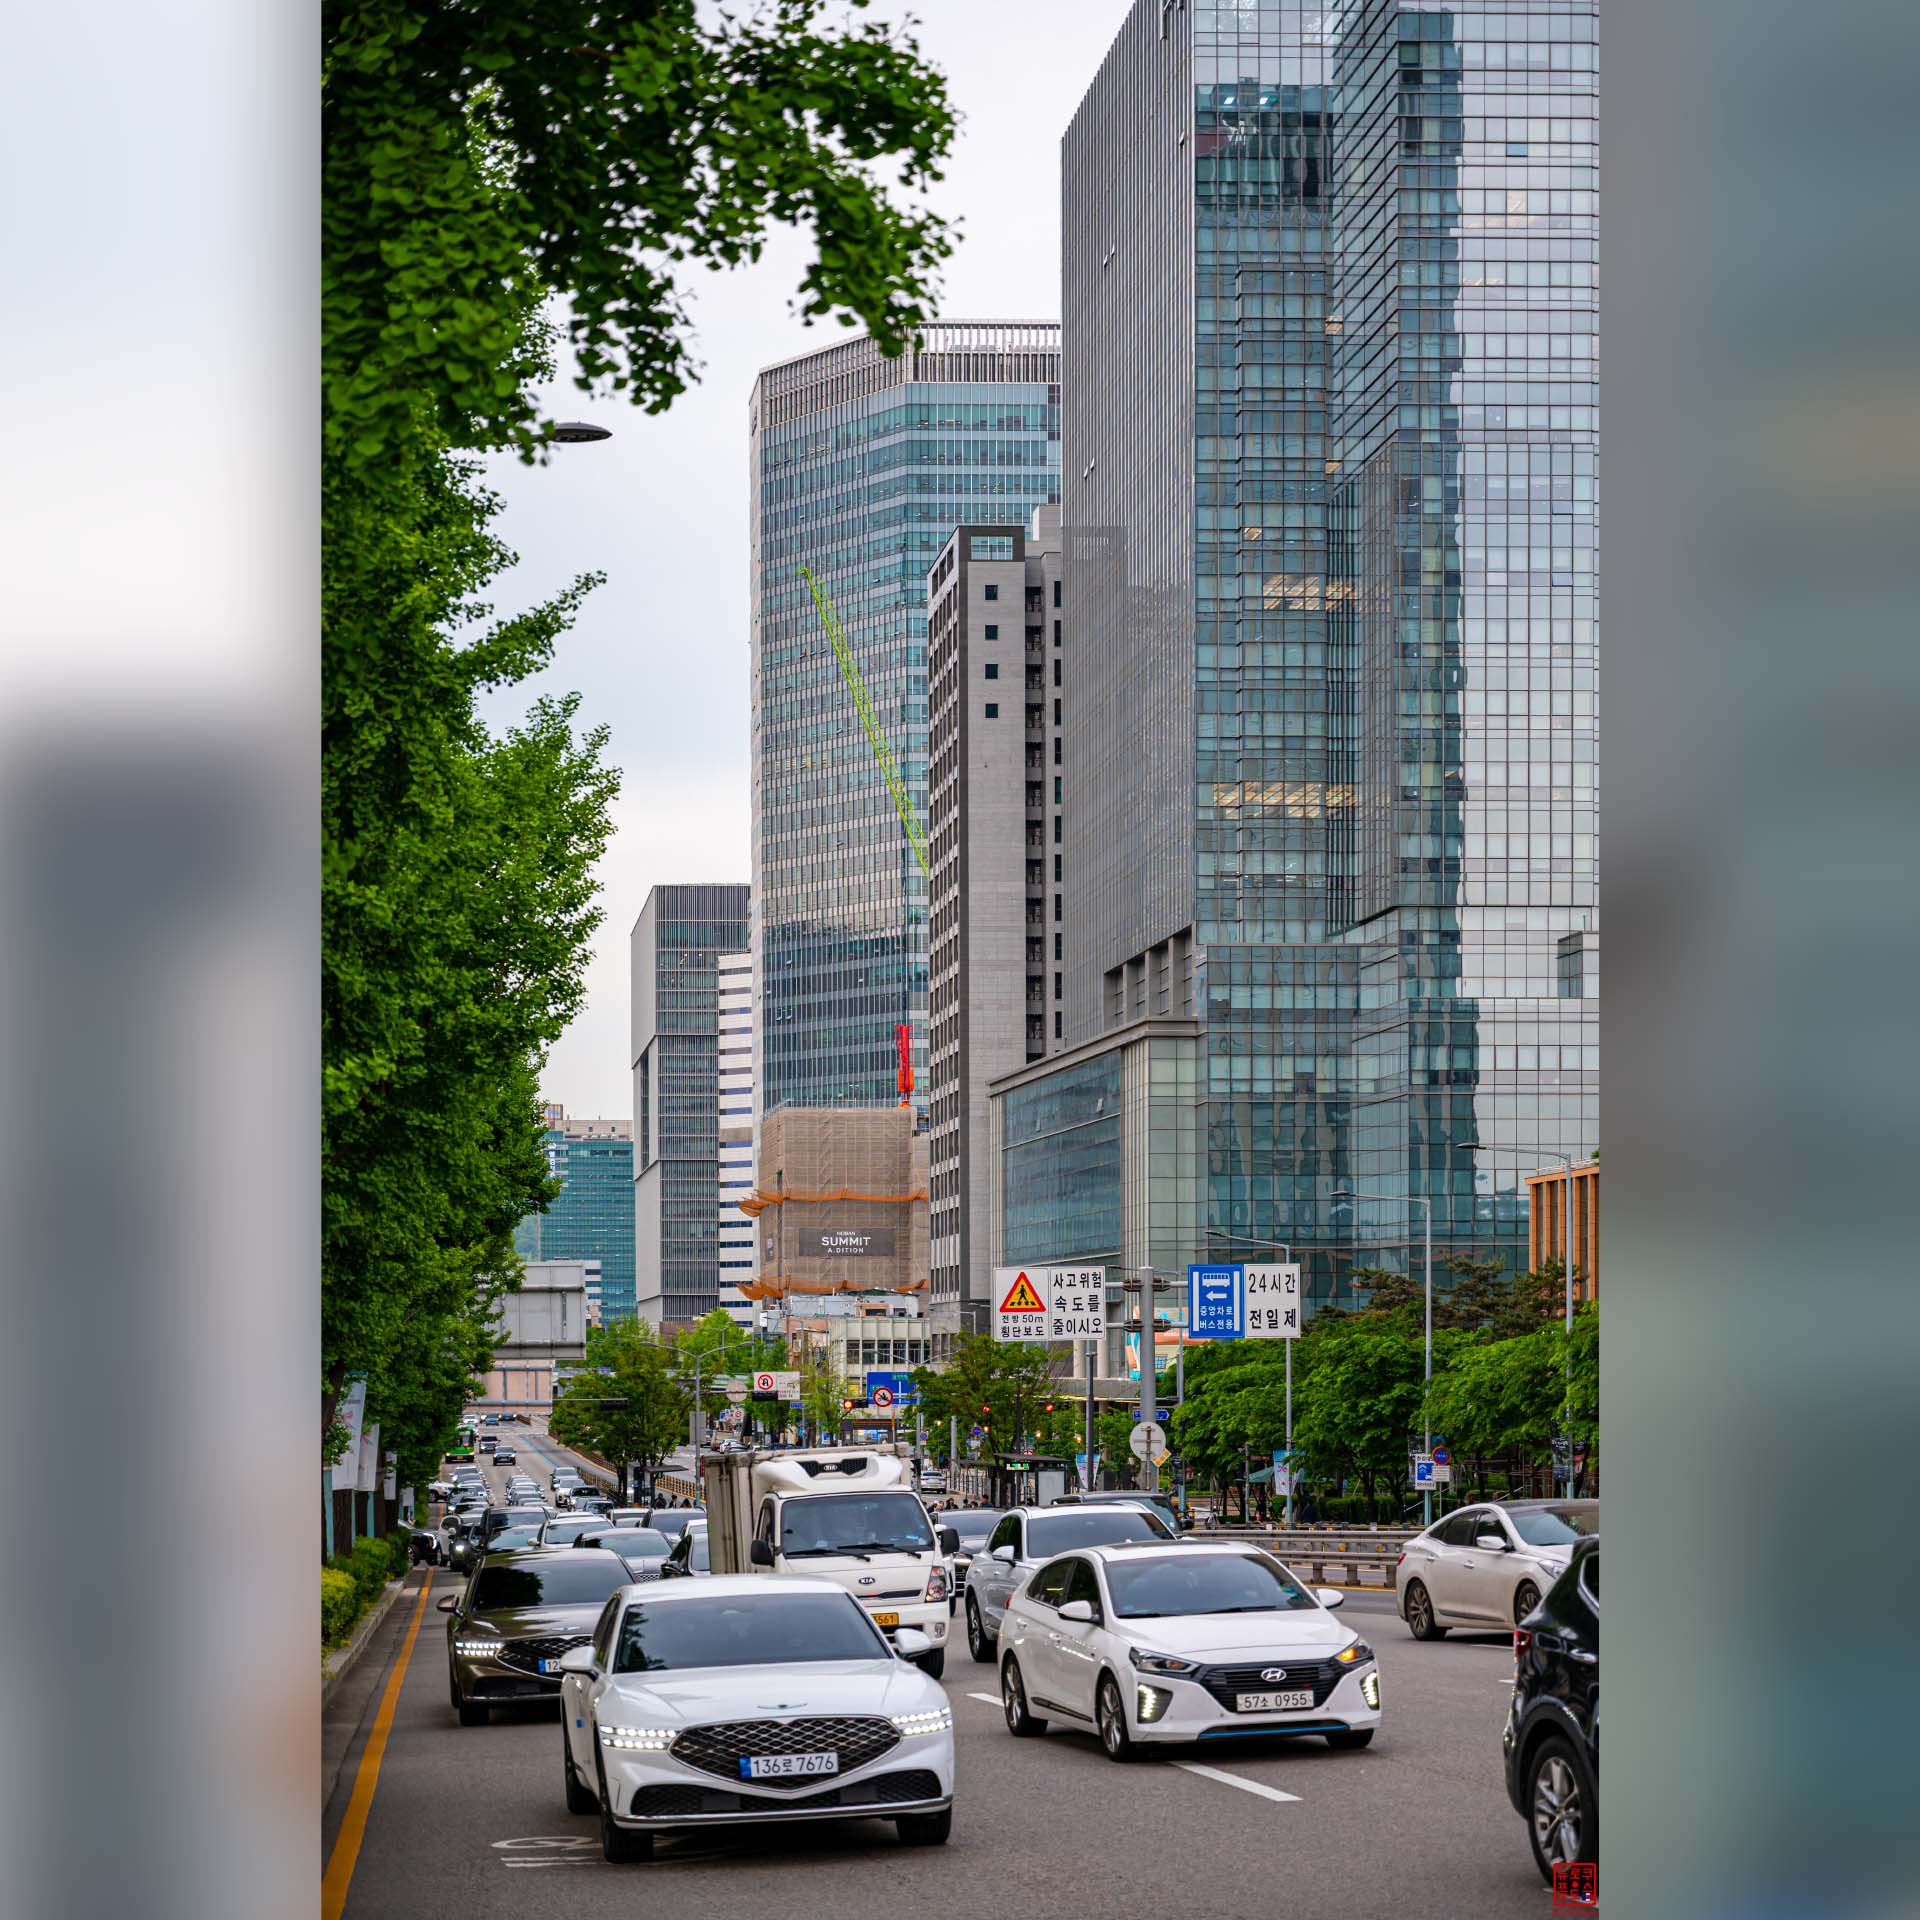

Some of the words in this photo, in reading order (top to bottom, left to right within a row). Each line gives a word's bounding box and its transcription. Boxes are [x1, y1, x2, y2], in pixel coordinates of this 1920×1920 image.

[821, 1236, 871, 1246] SUMMIT
[1053, 1272, 1102, 1289] 사고위험
[1248, 1273, 1296, 1294] 24시간
[1054, 1294, 1100, 1312] 속도를
[1200, 1305, 1234, 1316] 중앙차로
[1022, 1314, 1044, 1323] 50m
[1053, 1318, 1103, 1335] 줄이시오
[1199, 1319, 1234, 1330] 버스전용
[1249, 1308, 1297, 1329] 전일제
[1001, 1326, 1045, 1338] 횡단보도
[547, 1660, 560, 1671] 12
[1244, 1695, 1269, 1709] 57소
[1275, 1693, 1307, 1707] 0955
[753, 1758, 793, 1775] 136로
[796, 1755, 834, 1772] 7676
